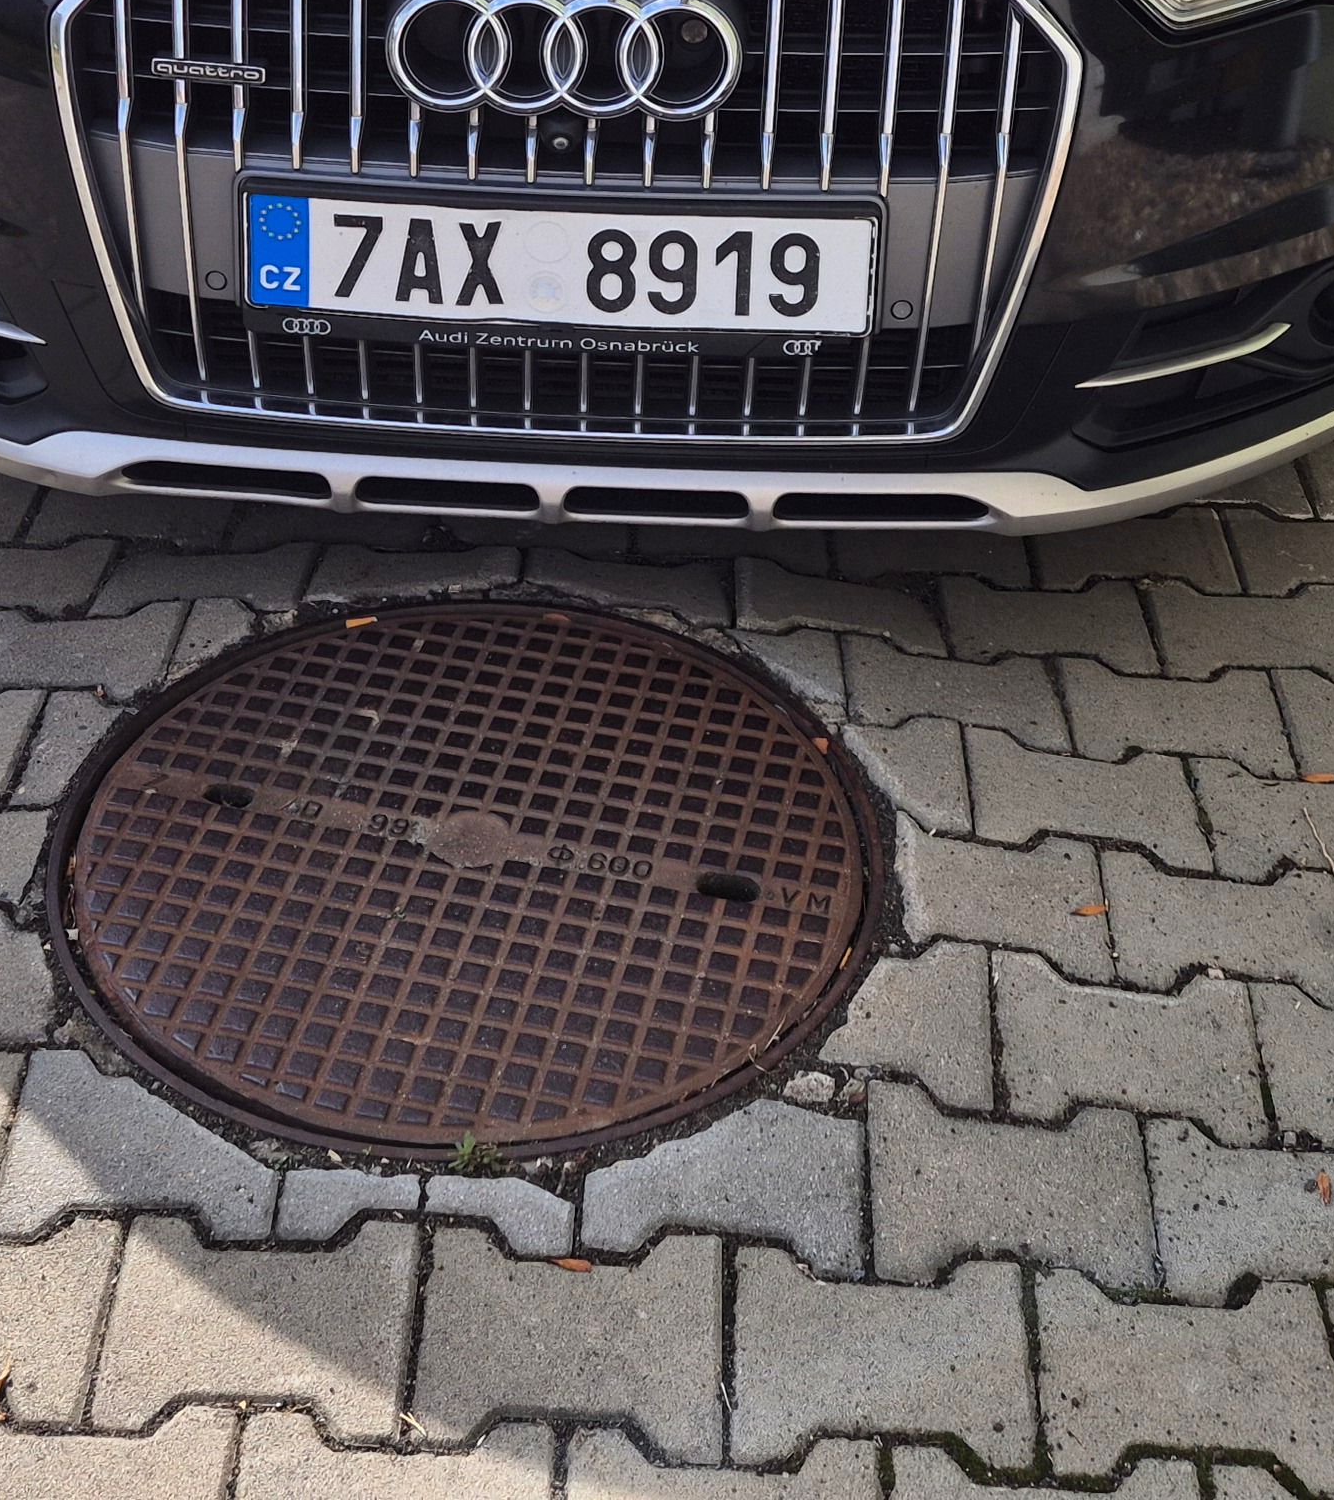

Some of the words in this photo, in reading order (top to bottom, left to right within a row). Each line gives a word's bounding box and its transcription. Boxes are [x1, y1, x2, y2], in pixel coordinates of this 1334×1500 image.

[156, 63, 260, 80] quattro
[259, 263, 301, 292] CZ
[332, 214, 504, 306] 7AX
[585, 228, 821, 318] 8919
[418, 329, 468, 344] Audi
[475, 331, 573, 349] Zentrum
[580, 337, 700, 353] Osnabrück
